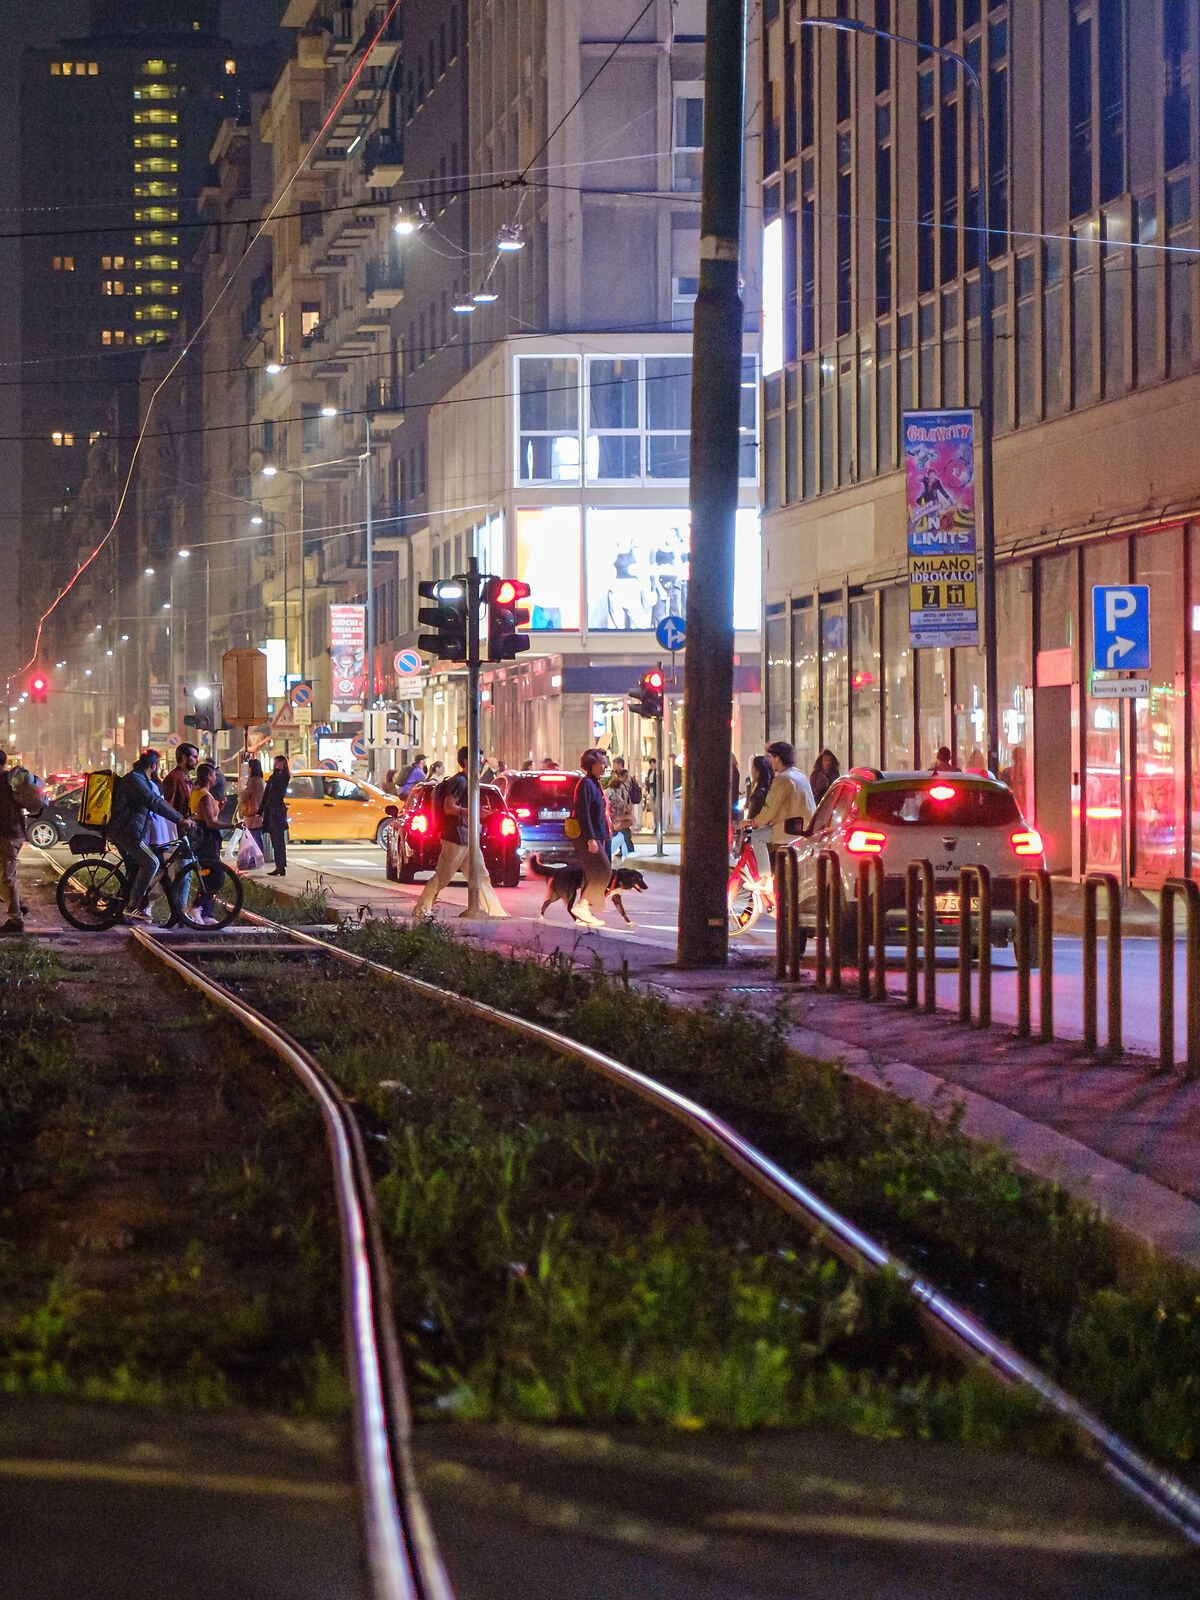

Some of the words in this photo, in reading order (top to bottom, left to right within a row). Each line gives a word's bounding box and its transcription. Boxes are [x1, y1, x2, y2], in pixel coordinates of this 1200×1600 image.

[906, 424, 970, 442] GRAVITY
[912, 531, 970, 546] LIMITS
[913, 557, 970, 571] MILANO
[911, 571, 974, 583] IDROSCALO
[927, 590, 936, 604] 7
[949, 589, 964, 603] 11
[1106, 591, 1137, 632] P
[332, 619, 358, 627] GIOCHI
[1140, 684, 1148, 692] 21
